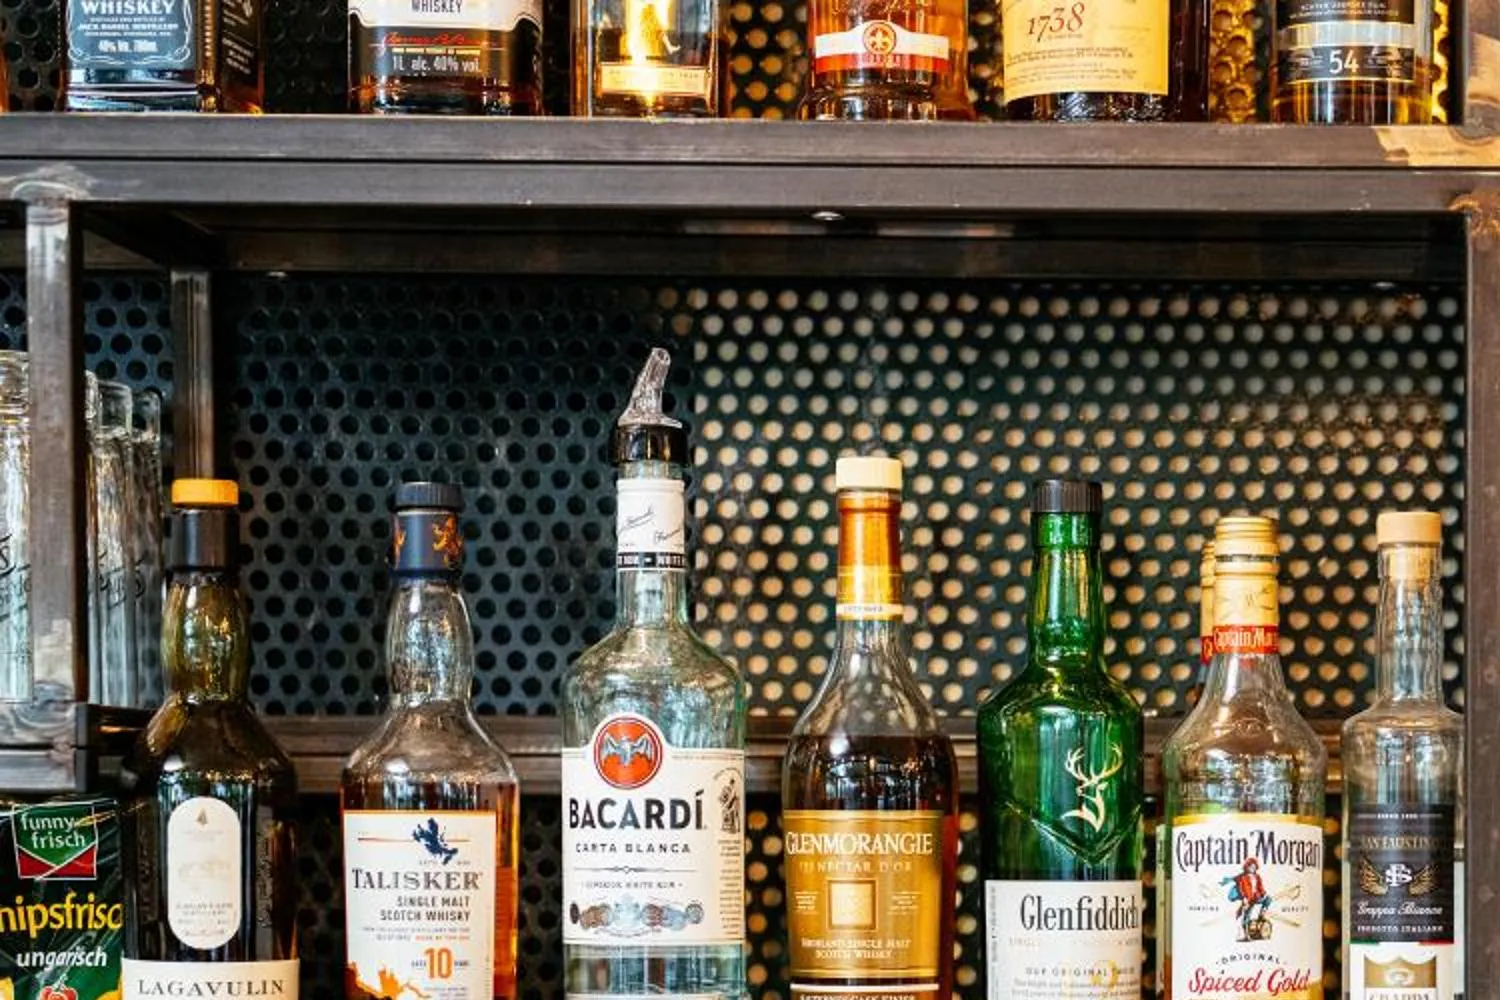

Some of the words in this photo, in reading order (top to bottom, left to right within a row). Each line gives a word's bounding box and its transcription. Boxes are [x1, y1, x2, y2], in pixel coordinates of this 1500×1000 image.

[82, 0, 175, 15] WHISKEY
[411, 0, 464, 13] WHISKEY
[1027, 2, 1085, 42] 1738
[1329, 49, 1359, 74] 54
[569, 788, 704, 830] BACARDÍ
[20, 813, 75, 832] funny
[31, 831, 86, 849] frisch
[575, 843, 617, 853] CARTA
[624, 843, 691, 853] BLANCA
[786, 831, 933, 856] GLENMORANGIE
[1176, 830, 1248, 872] Captain
[1250, 830, 1321, 873] Morgan
[351, 868, 481, 890] TALISKER
[397, 895, 438, 907] SINGLE
[441, 895, 470, 907] MALT
[1020, 894, 1139, 931] Glenfiddich
[379, 910, 421, 922] SCOTCH
[425, 910, 471, 922] WHISKY
[16, 946, 108, 972] ungarisch
[424, 947, 453, 979] 10
[138, 979, 285, 997] LAGAVULIN
[1188, 967, 1263, 996] Spiced
[1267, 967, 1311, 996] Gold
